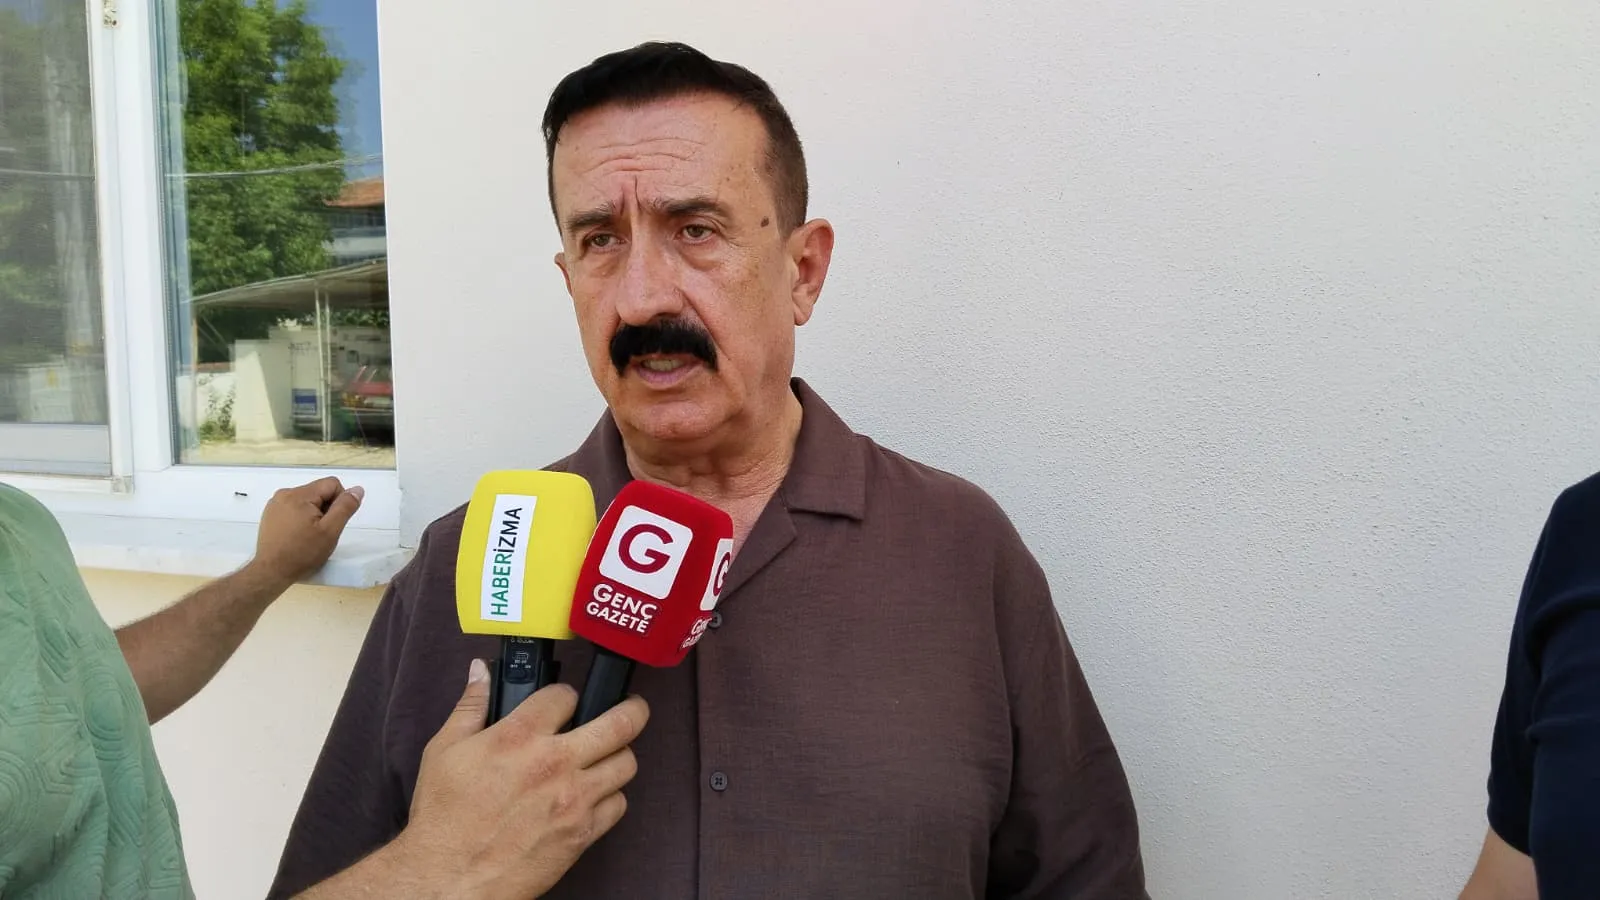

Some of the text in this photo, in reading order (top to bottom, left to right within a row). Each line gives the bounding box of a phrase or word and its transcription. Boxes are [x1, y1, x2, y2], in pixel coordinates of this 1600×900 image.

[491, 507, 522, 616] HABERİZMA
[618, 523, 674, 574] G
[586, 602, 649, 633] GAZETE
[593, 583, 657, 620] GENÇ
